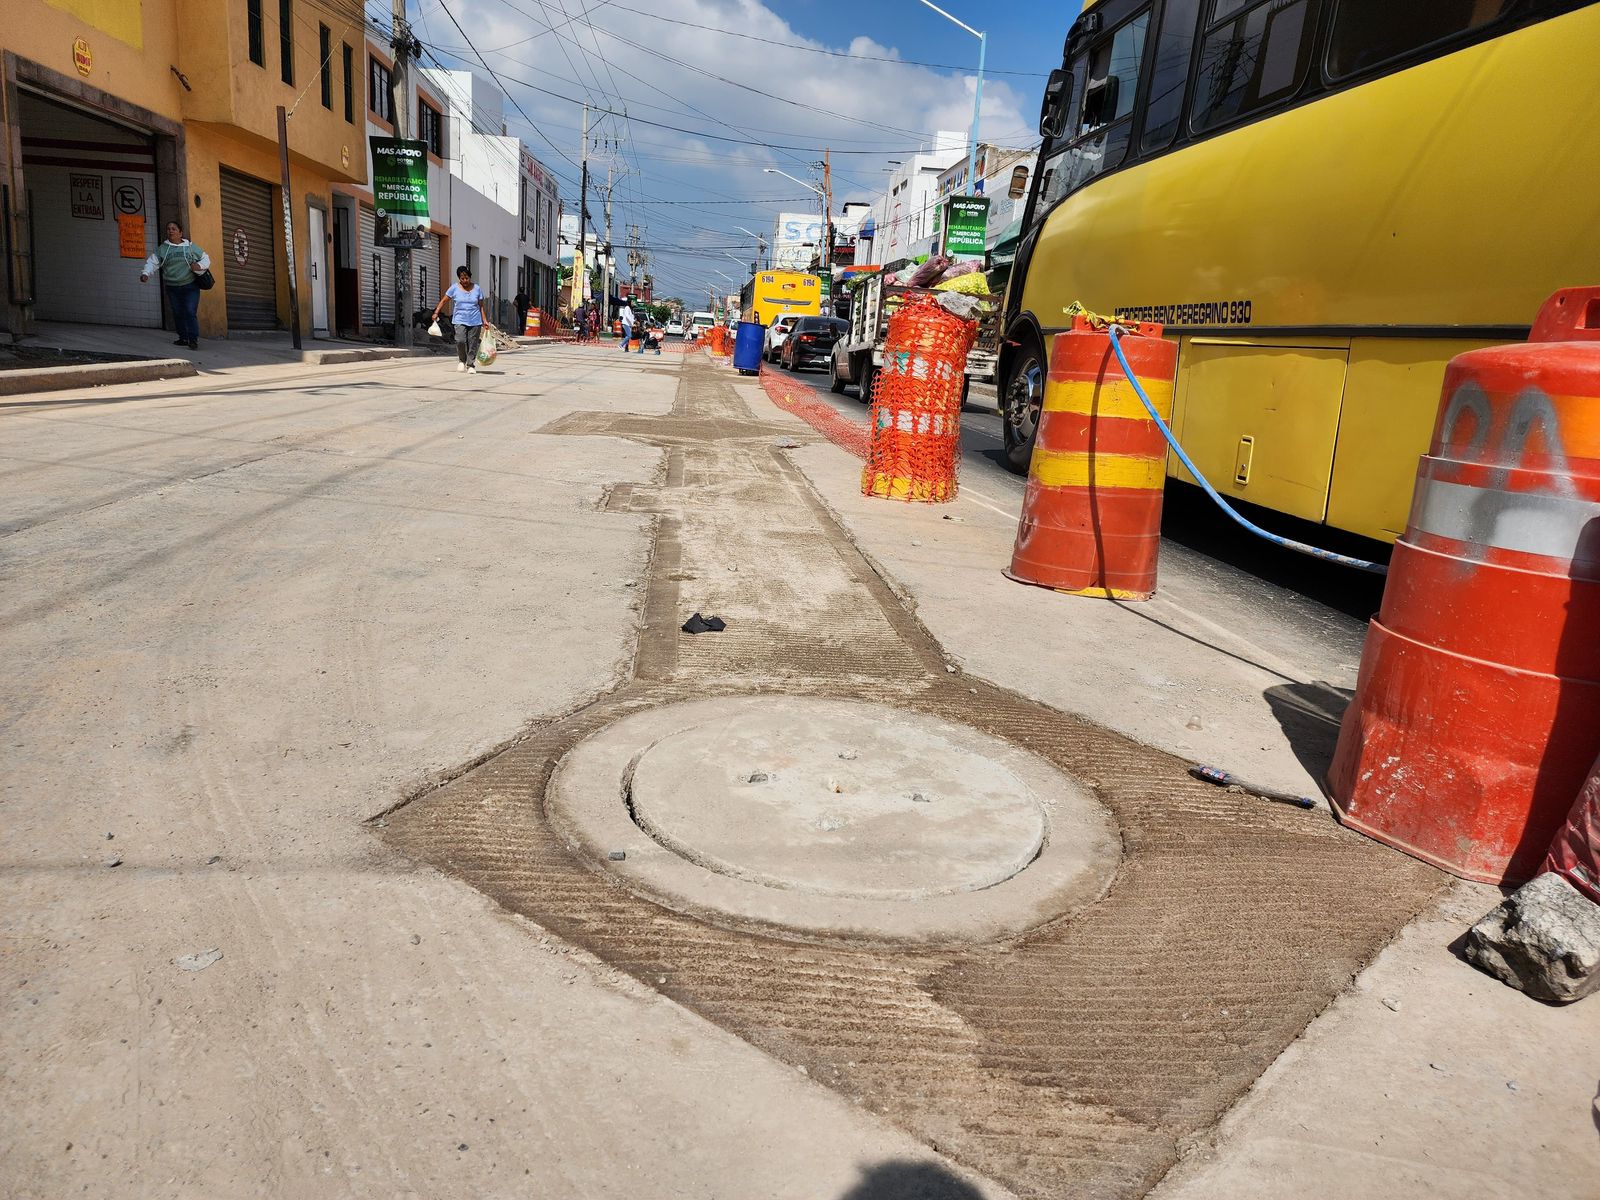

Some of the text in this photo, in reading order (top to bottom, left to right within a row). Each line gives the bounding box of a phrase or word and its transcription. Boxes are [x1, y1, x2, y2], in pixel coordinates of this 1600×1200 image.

[396, 149, 422, 157] APOYO
[375, 176, 427, 184] REHABILITAMOS
[79, 191, 95, 202] LA
[378, 191, 426, 202] REPÚBLICA
[949, 236, 984, 244] REPÚBLICA
[1153, 304, 1176, 325] BENZ
[1176, 302, 1229, 325] PEREGRINO
[1229, 300, 1252, 324] 930
